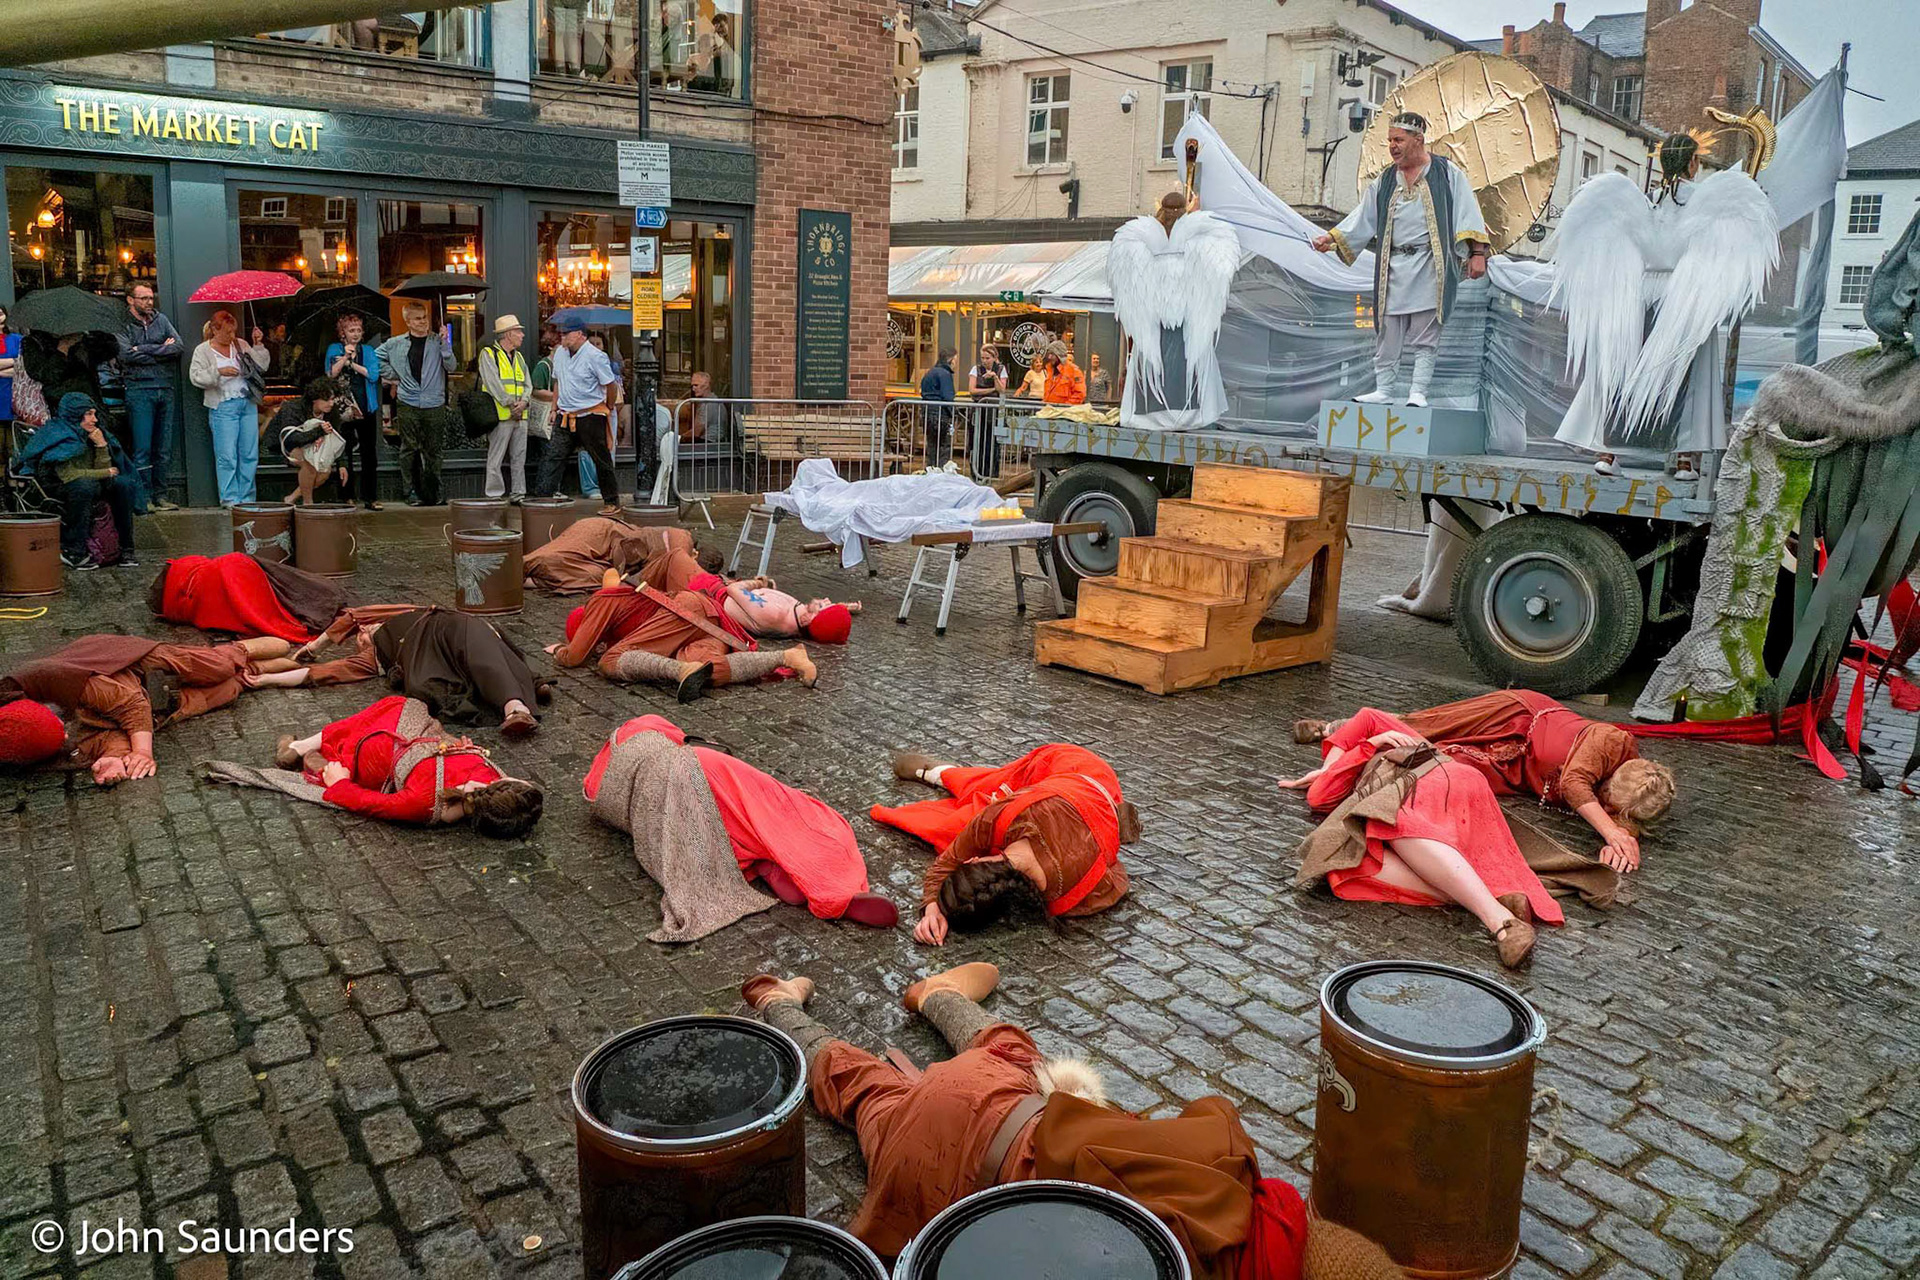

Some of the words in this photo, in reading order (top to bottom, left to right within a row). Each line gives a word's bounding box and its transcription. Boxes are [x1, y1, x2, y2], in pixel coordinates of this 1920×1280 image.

[56, 98, 121, 134] THE
[132, 105, 261, 146] MARKET
[269, 119, 323, 151] CAT
[640, 172, 649, 180] M
[806, 222, 846, 255] THORNBRIDGE
[824, 258, 836, 268] CO
